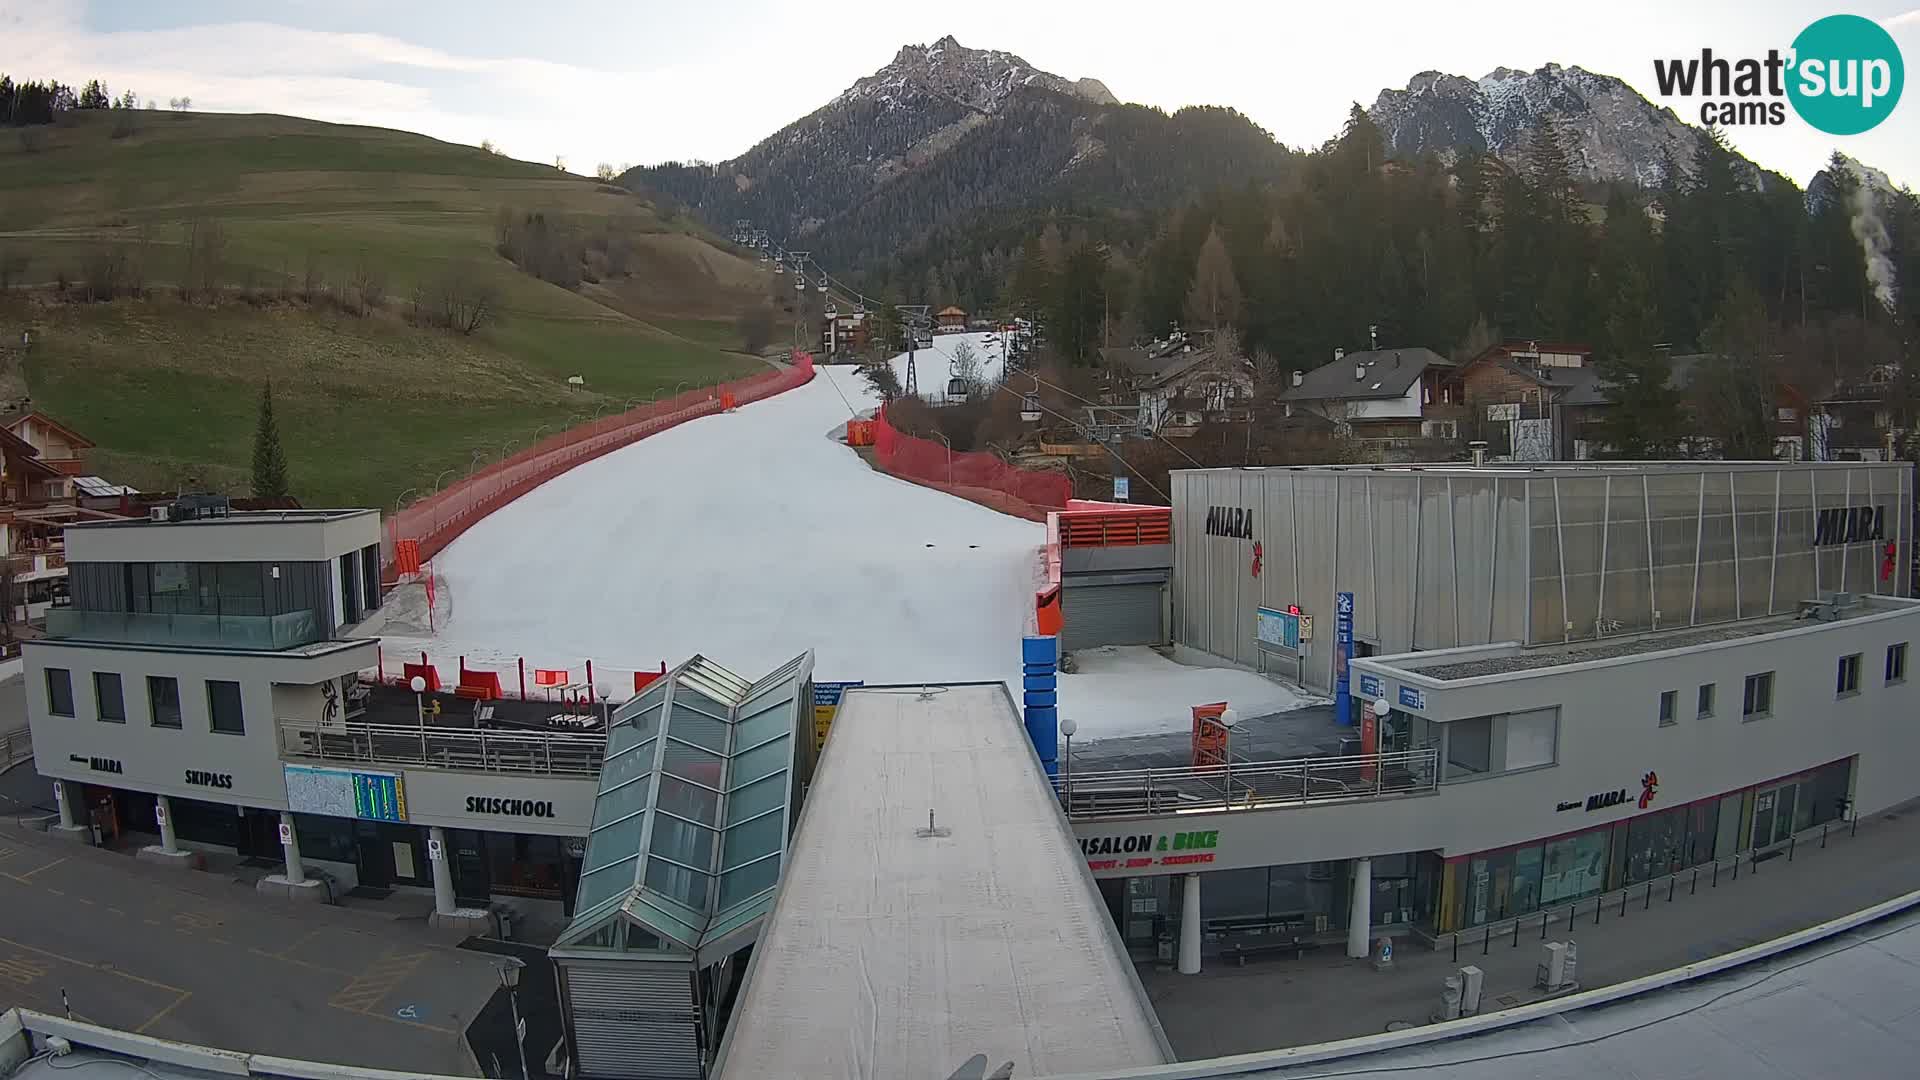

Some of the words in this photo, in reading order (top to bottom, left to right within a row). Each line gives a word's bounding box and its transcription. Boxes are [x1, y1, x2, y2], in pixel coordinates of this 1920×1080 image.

[1206, 506, 1252, 540] MIARA
[1814, 506, 1884, 546] MIARA
[90, 757, 123, 774] MIARA
[185, 770, 233, 789] SKIPASS
[466, 796, 555, 818] SKISCHOOL
[1585, 788, 1626, 812] MIARA
[1173, 830, 1218, 850] BIKE
